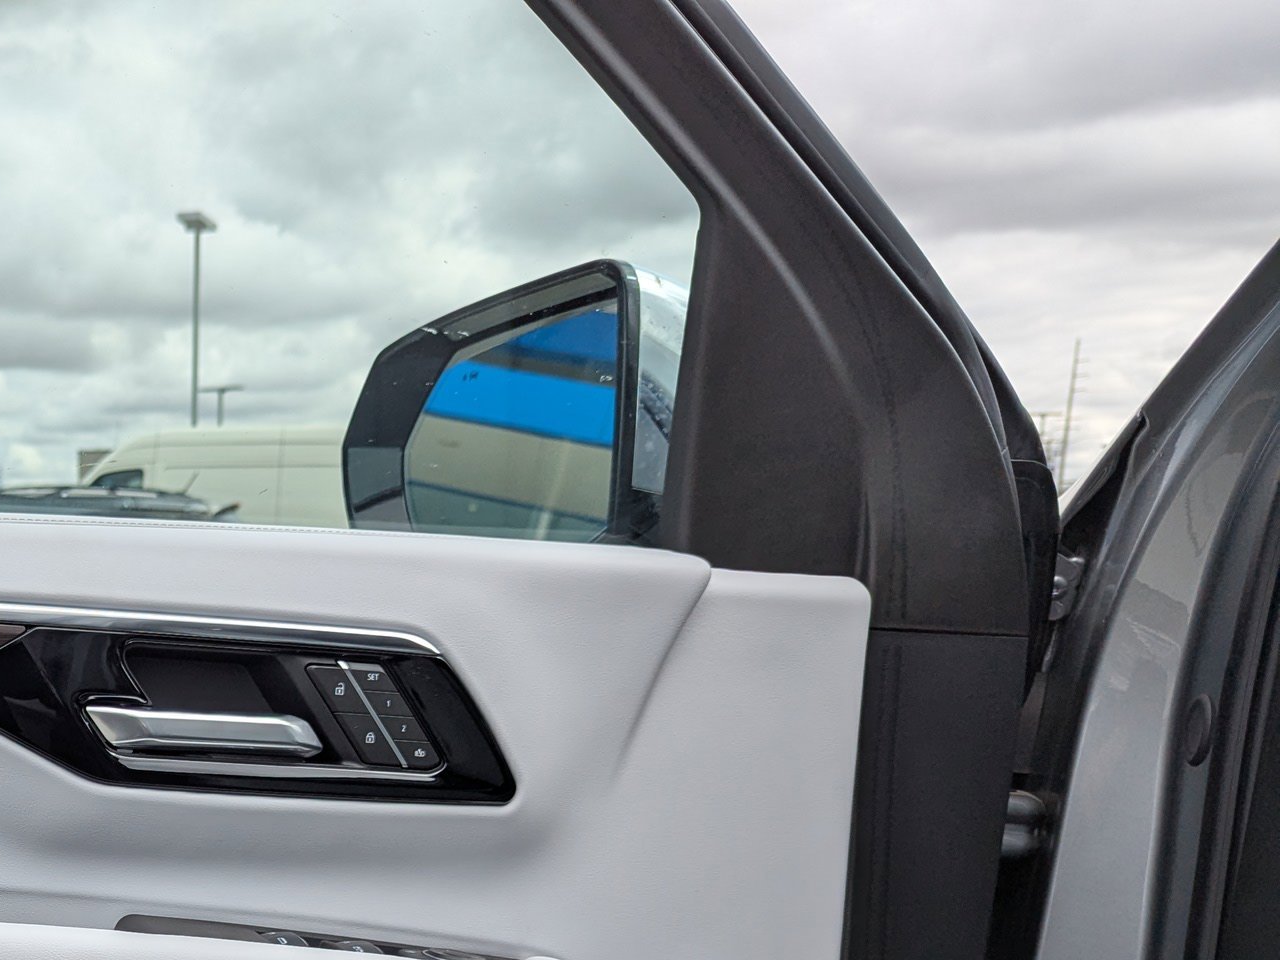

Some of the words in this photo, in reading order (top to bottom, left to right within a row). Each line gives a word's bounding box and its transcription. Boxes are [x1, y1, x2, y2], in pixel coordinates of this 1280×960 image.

[367, 673, 379, 681] SET
[386, 700, 391, 708] 1
[401, 724, 407, 733] 2
